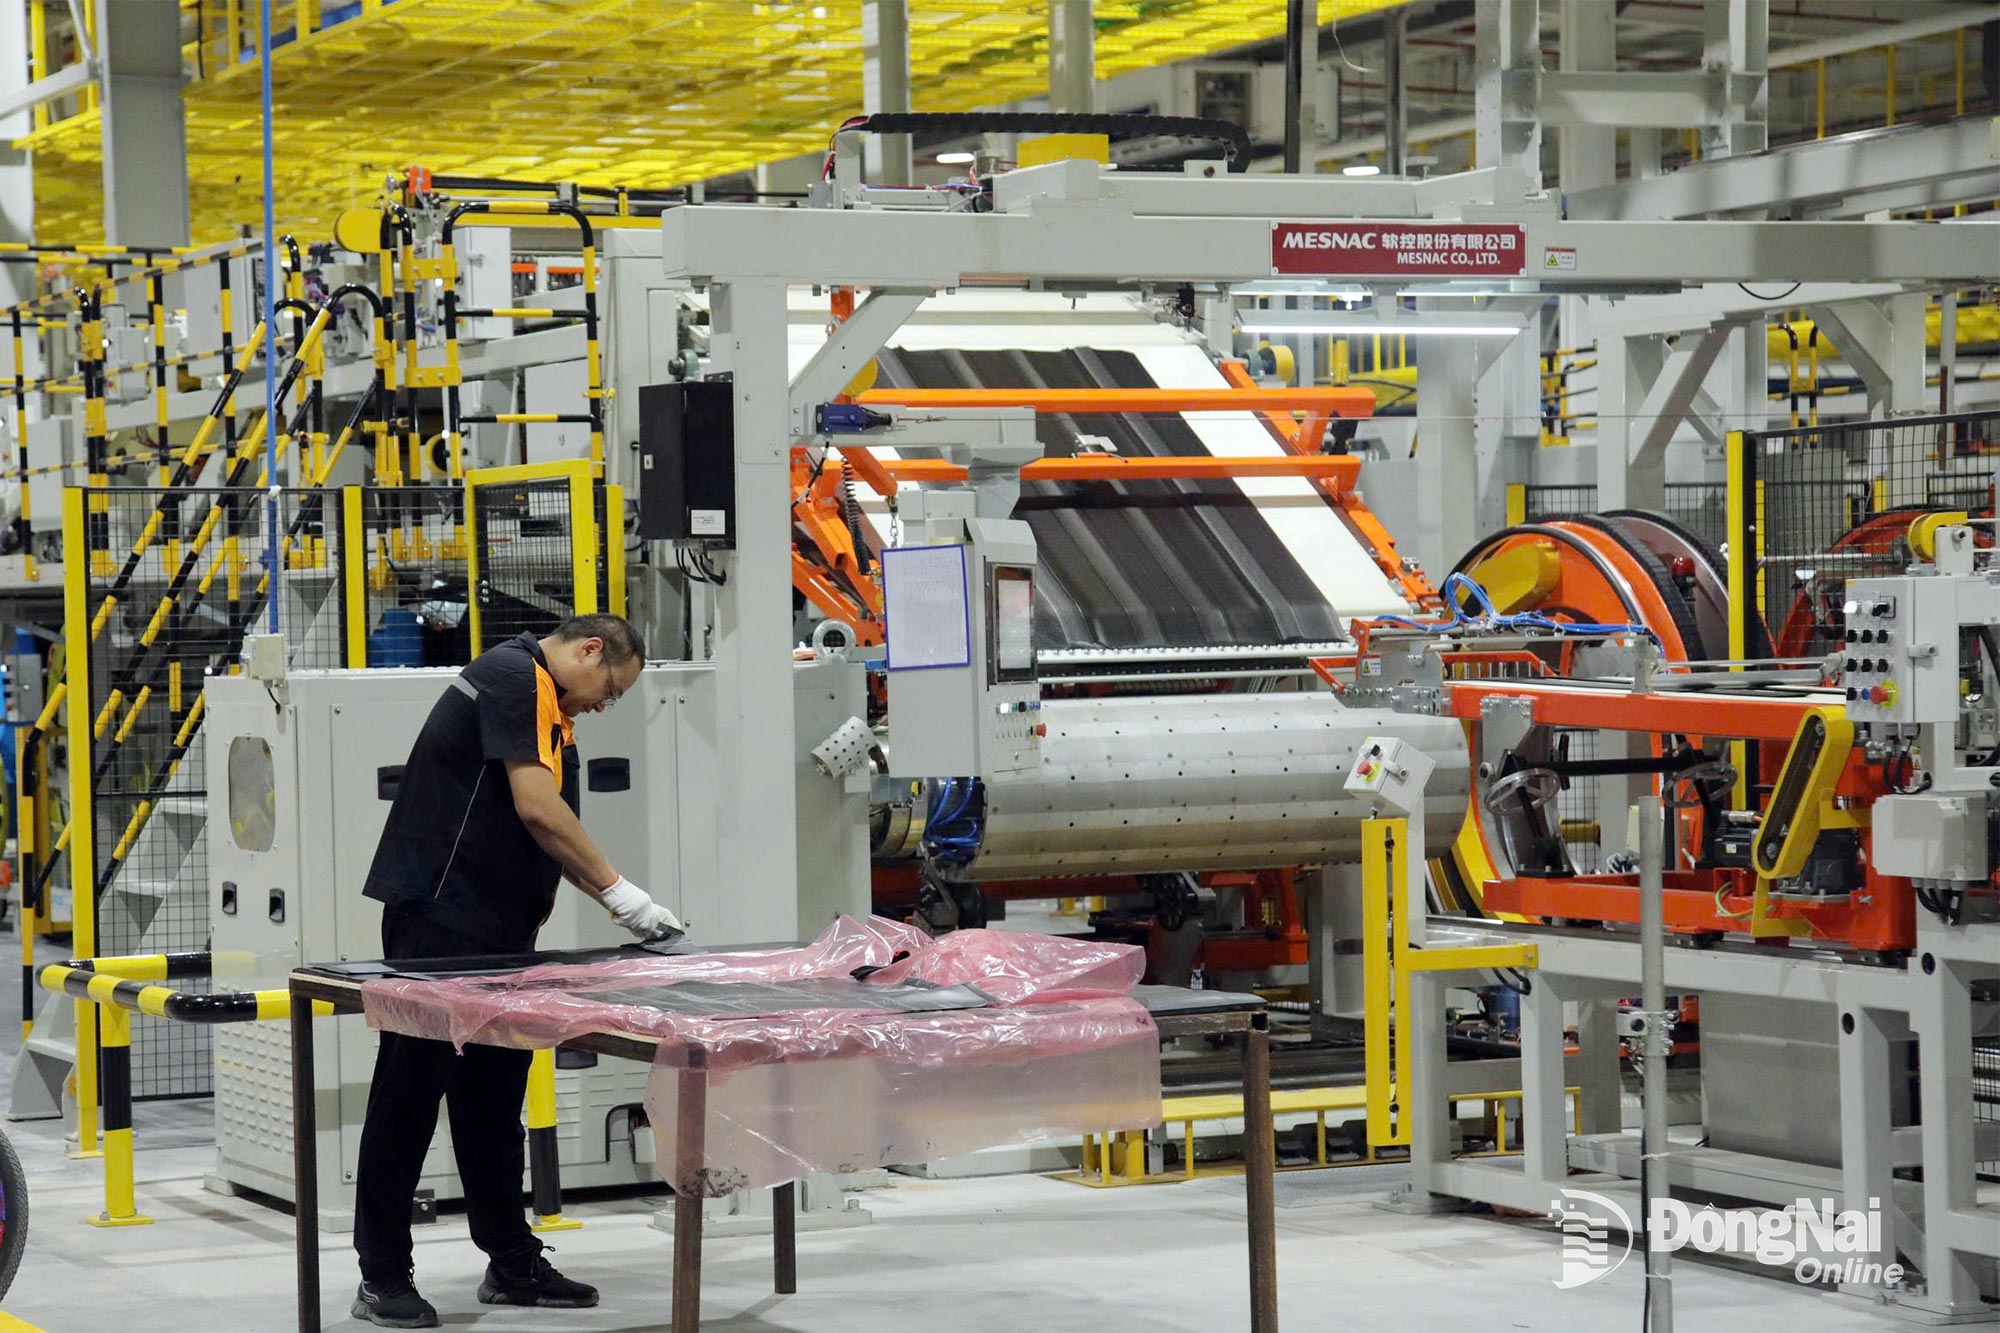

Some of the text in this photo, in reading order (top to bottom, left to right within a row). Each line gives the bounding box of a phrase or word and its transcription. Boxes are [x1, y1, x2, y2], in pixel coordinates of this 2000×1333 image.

[1282, 232, 1516, 250] MESNAC 软控股份有限公司
[1397, 252, 1448, 264] MESNAC
